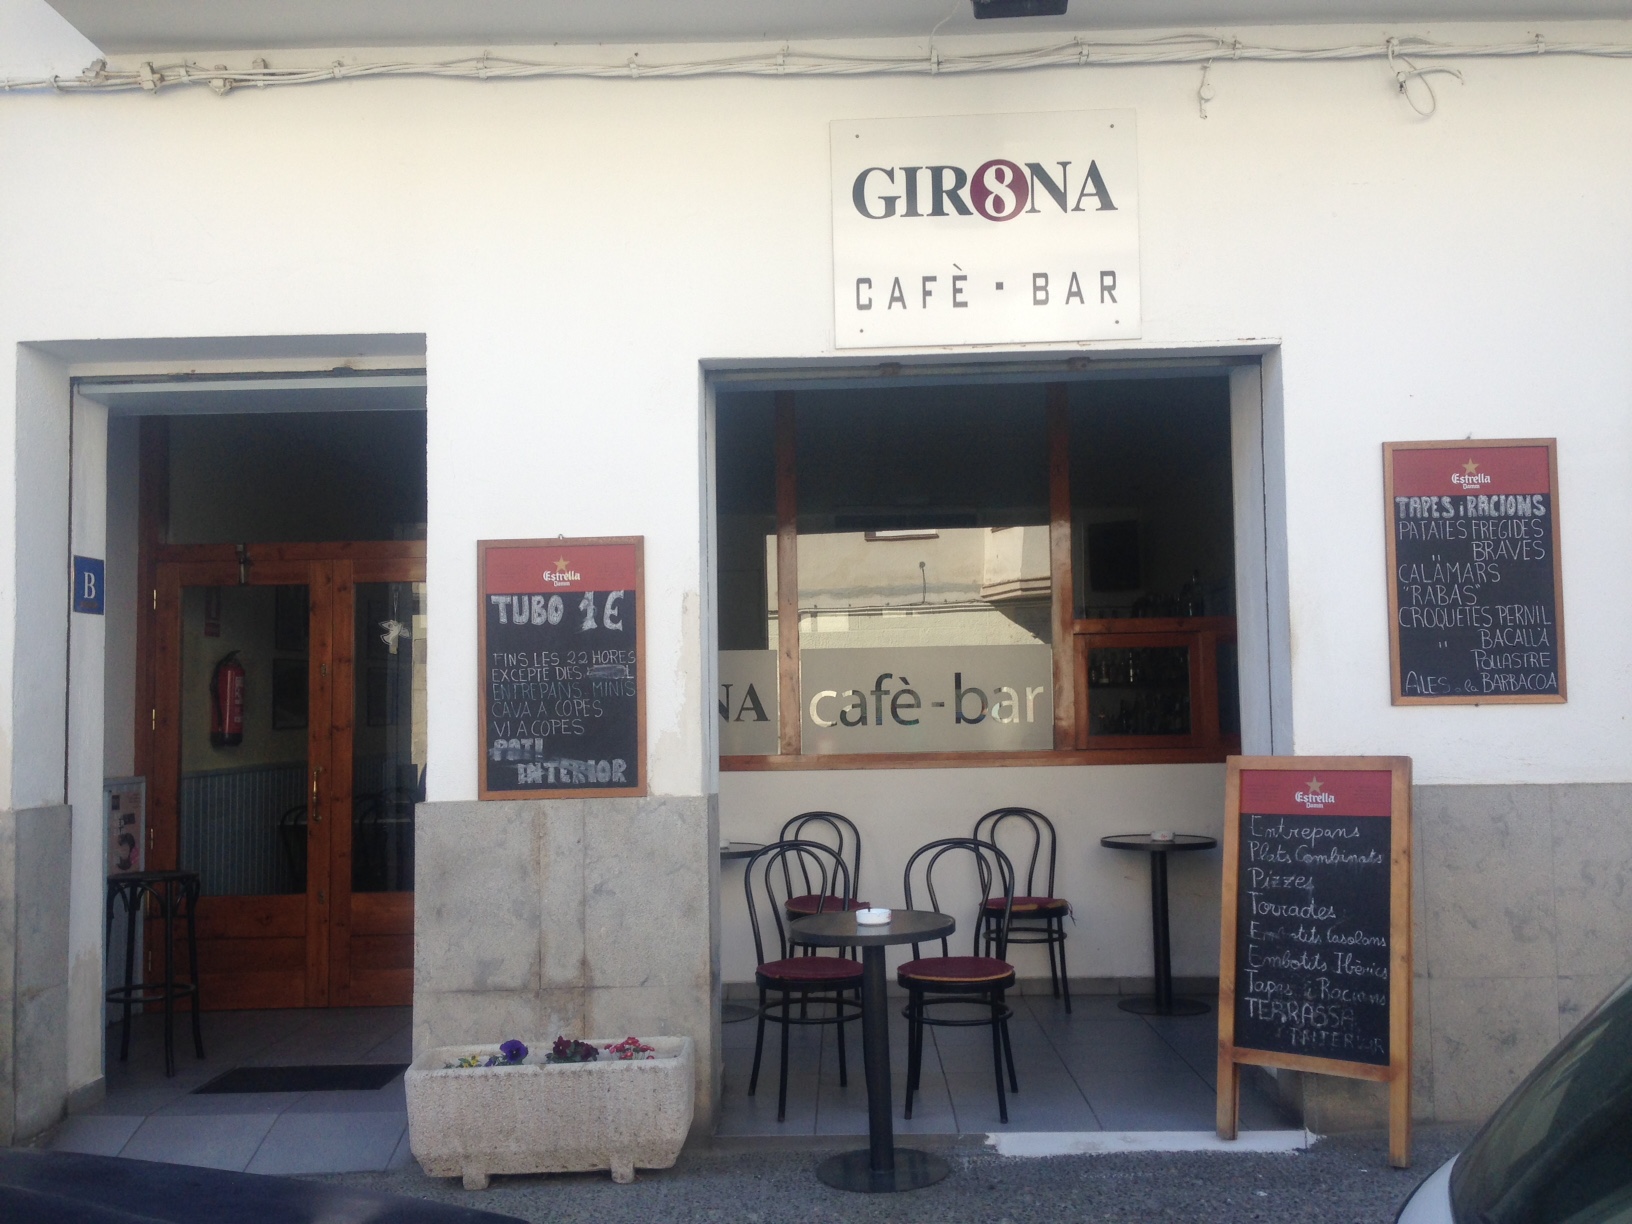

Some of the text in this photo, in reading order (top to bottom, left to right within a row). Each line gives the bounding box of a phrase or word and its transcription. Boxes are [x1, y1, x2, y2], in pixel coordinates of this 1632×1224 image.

[856, 263, 968, 310] CAFÈ
[1032, 270, 1118, 306] BAR
[1451, 472, 1491, 484] Estrella
[1395, 496, 1455, 519] TAPES
[1466, 494, 1547, 518] RACIONS
[1398, 518, 1544, 541] PATATES FREGIDES
[1471, 540, 1546, 562] BRAVES
[542, 570, 581, 582] Estrella
[1398, 562, 1501, 584] CALAMARS
[83, 571, 96, 599] B
[490, 594, 564, 626] TUBO
[1399, 603, 1552, 630] CROQUETES PERNIL
[493, 649, 636, 668] FINS LES 22 HORES
[491, 666, 550, 683] EXCEPTE
[555, 665, 583, 681] DIES
[1405, 670, 1451, 695] ALES
[1480, 671, 1558, 694] BARBACOA
[492, 680, 636, 701] ENTREPANS MINIS
[491, 699, 604, 718] CAVA A COPES
[493, 718, 585, 737] VI A COPES
[1295, 791, 1335, 803] Estrella
[1249, 815, 1360, 849] Entrepans
[1294, 844, 1384, 866] Combinats
[1248, 867, 1315, 890] Pizzes
[1248, 891, 1337, 920] Torrades
[1249, 944, 1328, 972] Embotits
